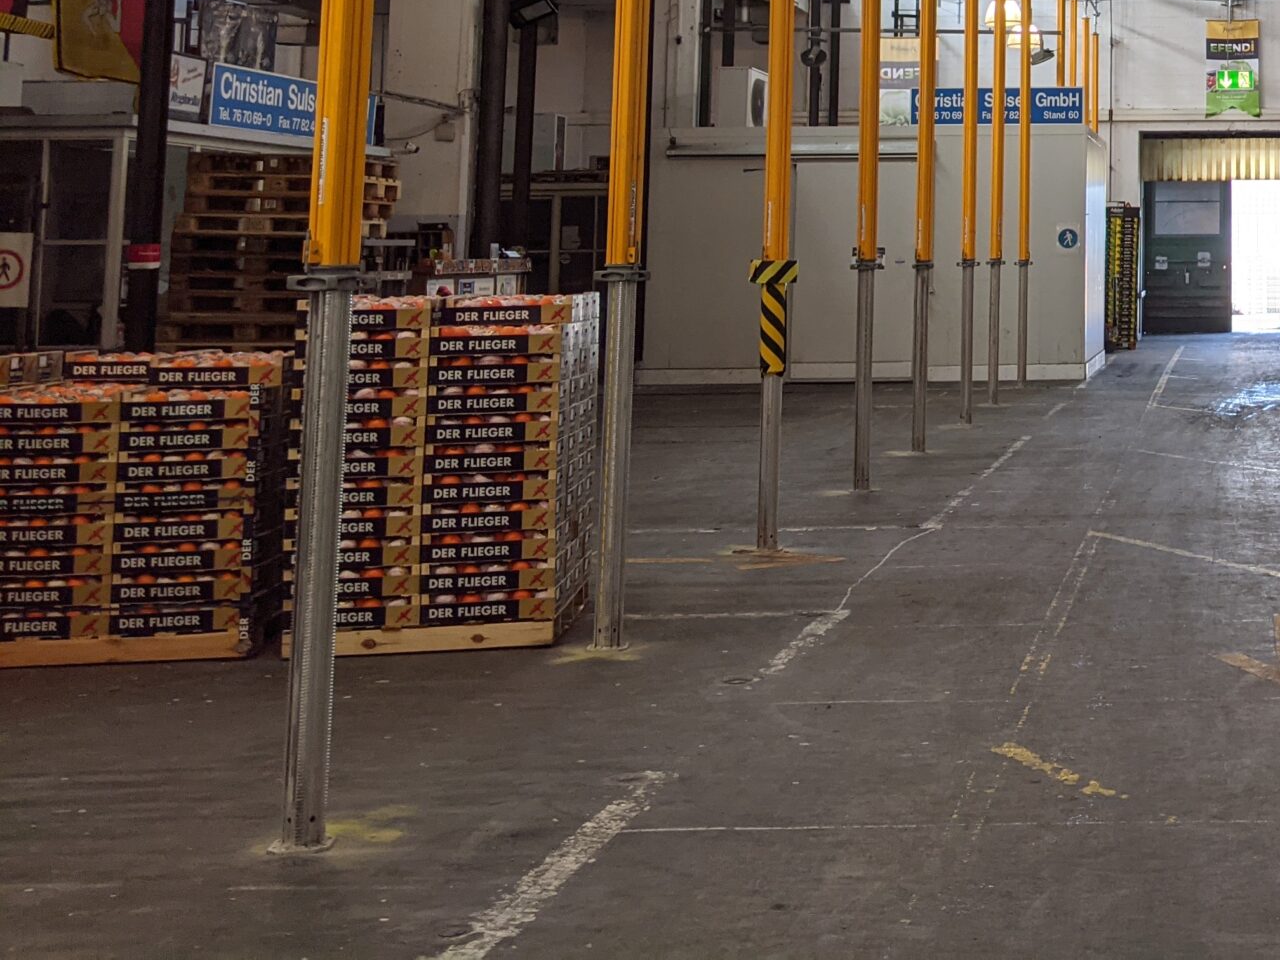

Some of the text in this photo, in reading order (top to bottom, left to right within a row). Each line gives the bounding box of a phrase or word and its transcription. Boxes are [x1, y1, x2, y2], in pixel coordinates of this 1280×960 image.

[220, 72, 283, 107] Christian
[288, 84, 316, 113] Suls
[1035, 92, 1080, 108] GmbH
[219, 107, 230, 121] Tel.
[278, 116, 291, 129] Fax
[940, 111, 951, 120] 70
[1043, 111, 1066, 120] Stand
[1068, 111, 1079, 120] 60
[352, 315, 384, 325] EGER
[456, 310, 529, 322] DER FLIEGER
[350, 344, 383, 354] EGER
[440, 340, 516, 351] DER FLIEGER
[73, 365, 147, 375] DER FLIEGER
[438, 369, 515, 380] DER FLIEGER
[159, 371, 236, 382] DER FLIEGER
[349, 373, 381, 384] EGER
[250, 383, 260, 404] DER
[347, 403, 379, 413] EGER
[438, 398, 515, 410] DER FLIEGER
[17, 407, 69, 418] FLIEGER
[132, 405, 212, 417] DER FLIEGER
[346, 432, 378, 443] EGER
[436, 427, 513, 439] DER FLIEGER
[18, 439, 70, 449] FLIEGER
[129, 435, 210, 447] DER FLIEGER
[343, 462, 376, 473] EGER
[435, 457, 512, 469] DER FLIEGER
[14, 468, 66, 479] FLIEGER
[128, 465, 209, 477] DER FLIEGER
[245, 460, 256, 482] DER
[342, 492, 375, 502] EGER
[434, 487, 511, 499] DER FLIEGER
[341, 522, 374, 533] EGER
[432, 516, 509, 529] DER FLIEGER
[12, 530, 64, 541] FLIEGER
[124, 525, 205, 538] DER FLIEGER
[242, 539, 252, 560] DER
[432, 546, 509, 559] DER FLIEGER
[121, 555, 201, 568] DER FLIEGER
[339, 552, 370, 562] EGER
[9, 560, 61, 571] FLIEGER
[338, 582, 369, 593] EGER
[429, 576, 507, 589] DER FLIEGER
[7, 591, 60, 602] FLIEGER
[120, 586, 201, 599] DER FLIEGER
[429, 605, 507, 619] DER FLIEGER
[4, 622, 57, 633] FLIEGER
[119, 616, 200, 629] DER FLIEGER
[240, 618, 249, 640] DER
